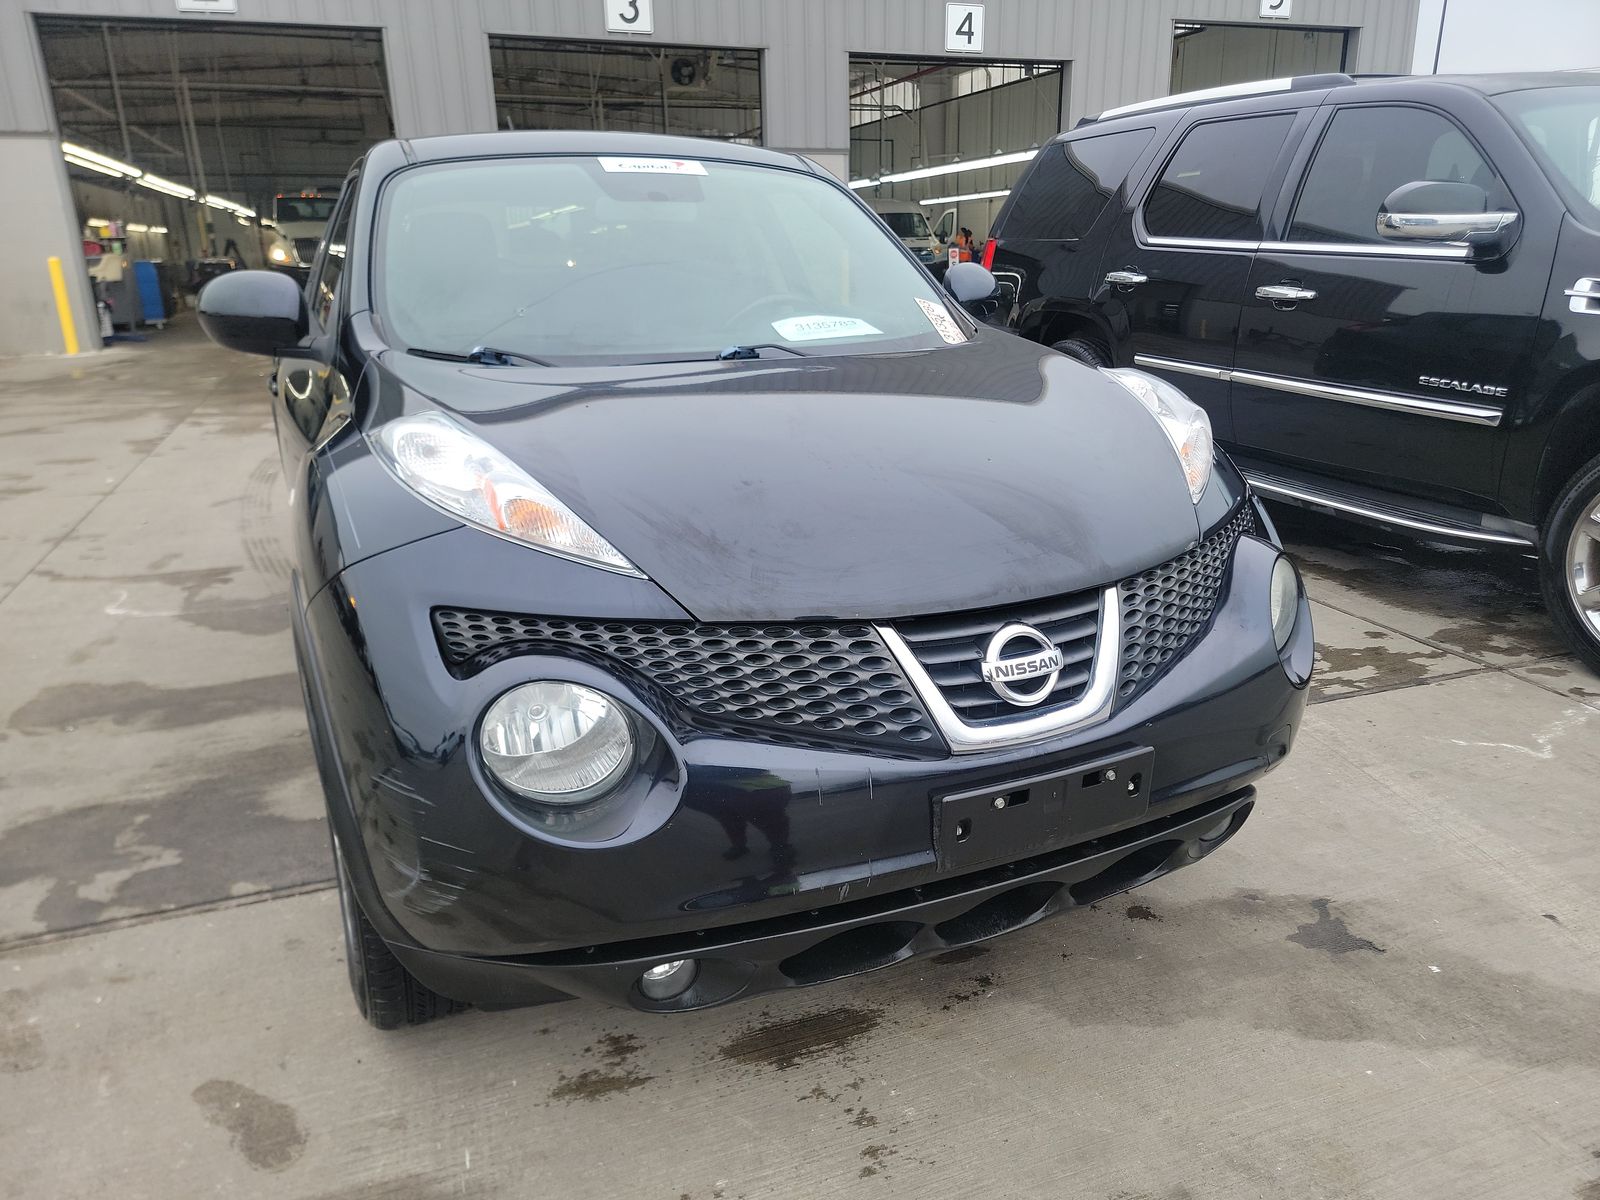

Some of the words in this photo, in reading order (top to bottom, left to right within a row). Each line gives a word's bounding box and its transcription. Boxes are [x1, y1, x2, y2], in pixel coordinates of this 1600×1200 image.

[619, 0, 640, 24] 3
[955, 12, 974, 45] 4
[1418, 375, 1508, 397] ESCALADE
[994, 654, 1059, 679] NISSAN
